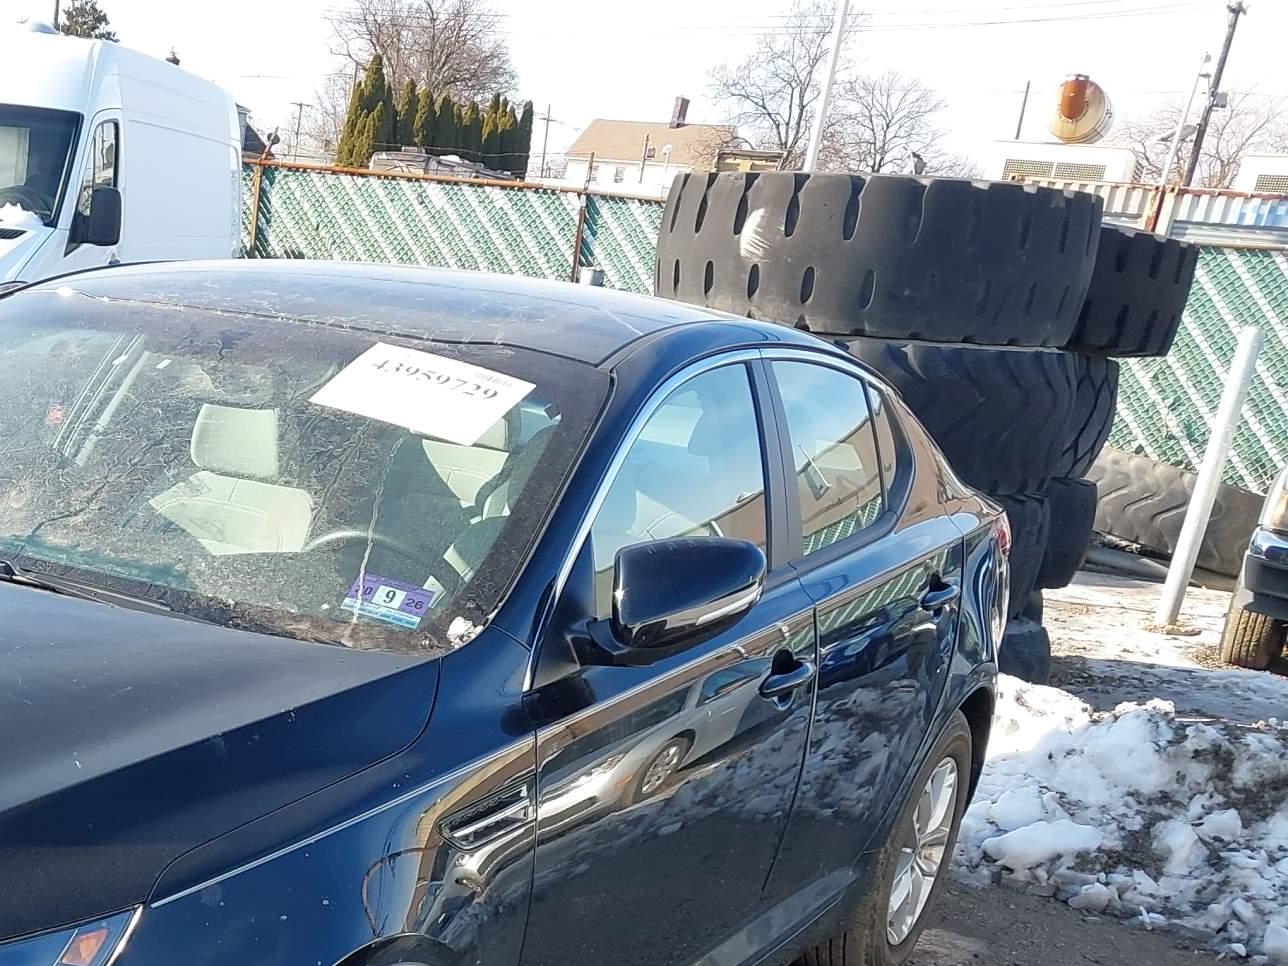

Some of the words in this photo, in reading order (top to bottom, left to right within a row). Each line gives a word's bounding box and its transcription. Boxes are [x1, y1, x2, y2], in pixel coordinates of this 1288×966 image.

[372, 359, 499, 400] 43959729
[383, 589, 397, 604] 9
[405, 598, 425, 610] 26
